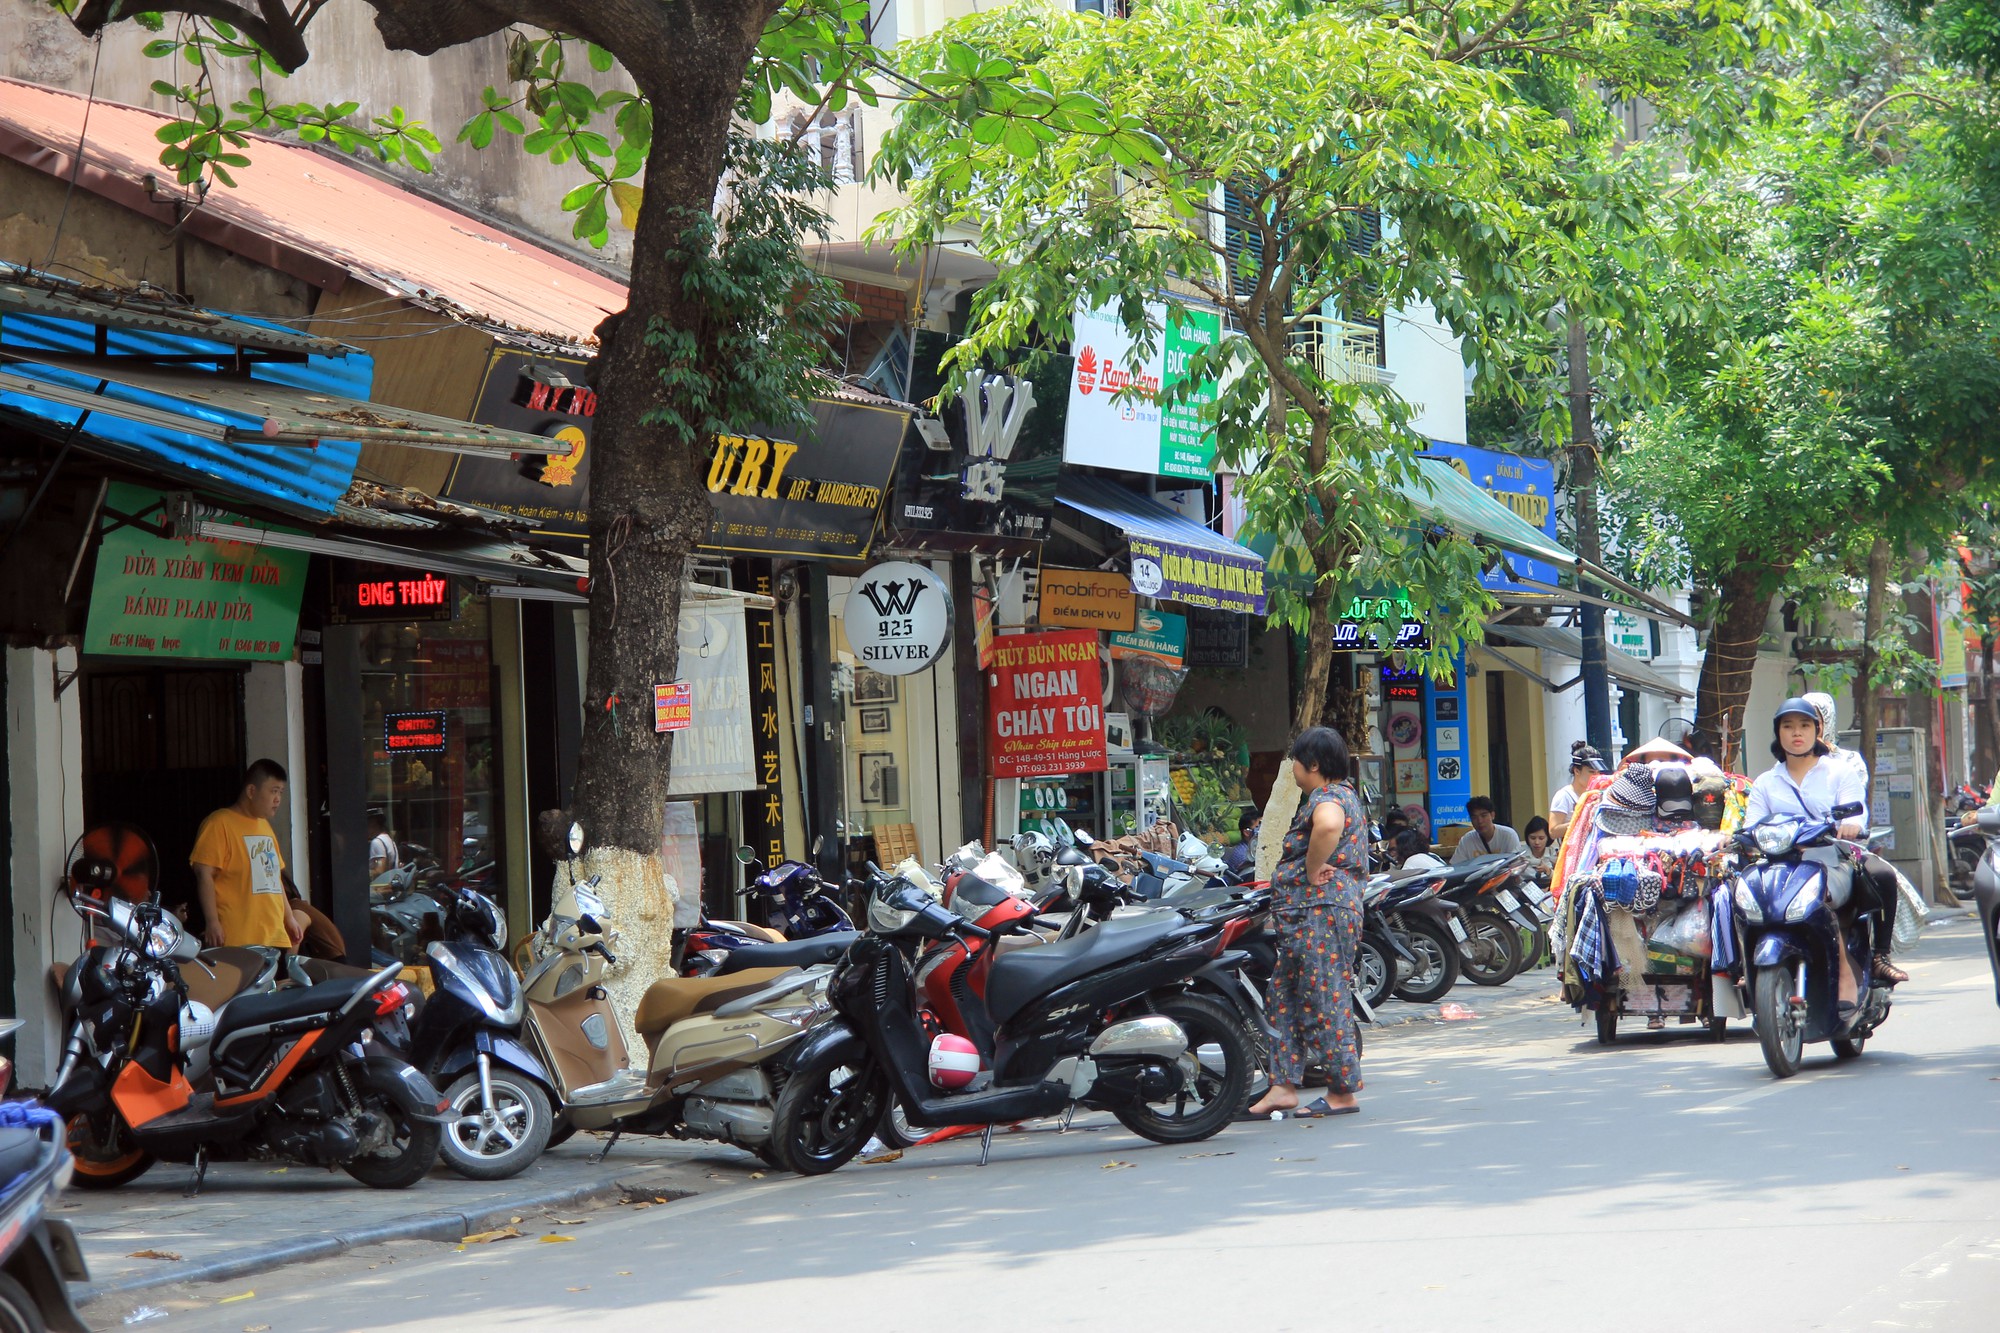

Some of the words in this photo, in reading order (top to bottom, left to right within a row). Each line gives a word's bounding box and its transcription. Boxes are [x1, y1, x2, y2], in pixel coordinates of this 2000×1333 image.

[1179, 322, 1193, 342] CỬA
[1194, 326, 1211, 344] HÀNG
[1167, 346, 1187, 377] ĐỨC
[707, 433, 798, 500] URY
[787, 480, 811, 501] ART
[815, 482, 880, 509] HANDICRAFTS
[123, 549, 157, 577] DỪA
[163, 554, 206, 581] XIÊM
[210, 563, 246, 583] KEM
[249, 559, 280, 585] DỪA
[1140, 564, 1150, 579] 14
[1046, 582, 1130, 599] mobifone
[123, 587, 169, 618] BÁNH
[174, 599, 219, 620] PLAN
[222, 596, 253, 621] DỪA
[1053, 606, 1079, 618] ĐIỂM
[1081, 610, 1104, 621] DỊCH
[1107, 611, 1121, 622] VỤ
[879, 619, 912, 636] 925
[862, 645, 929, 661] SILVER
[1028, 640, 1055, 665] BÚN
[1058, 641, 1097, 662] NGAN
[1116, 635, 1137, 647] ĐIỂM
[1139, 636, 1155, 650] BÁN
[1156, 640, 1180, 654] HÀNG
[657, 687, 675, 697] MUA
[1013, 669, 1078, 700] NGAN
[997, 704, 1056, 738] CHÁY
[1062, 696, 1100, 732] TỎI
[999, 756, 1014, 764] ĐC:
[1058, 749, 1080, 761] Hàng
[1081, 749, 1102, 762] Lược
[1015, 763, 1030, 774] ĐT:
[1031, 763, 1047, 773] 093
[1049, 762, 1064, 772] 231
[1065, 761, 1085, 771] 3939
[1047, 1003, 1079, 1021] SH
[723, 1022, 762, 1032] LEAD
